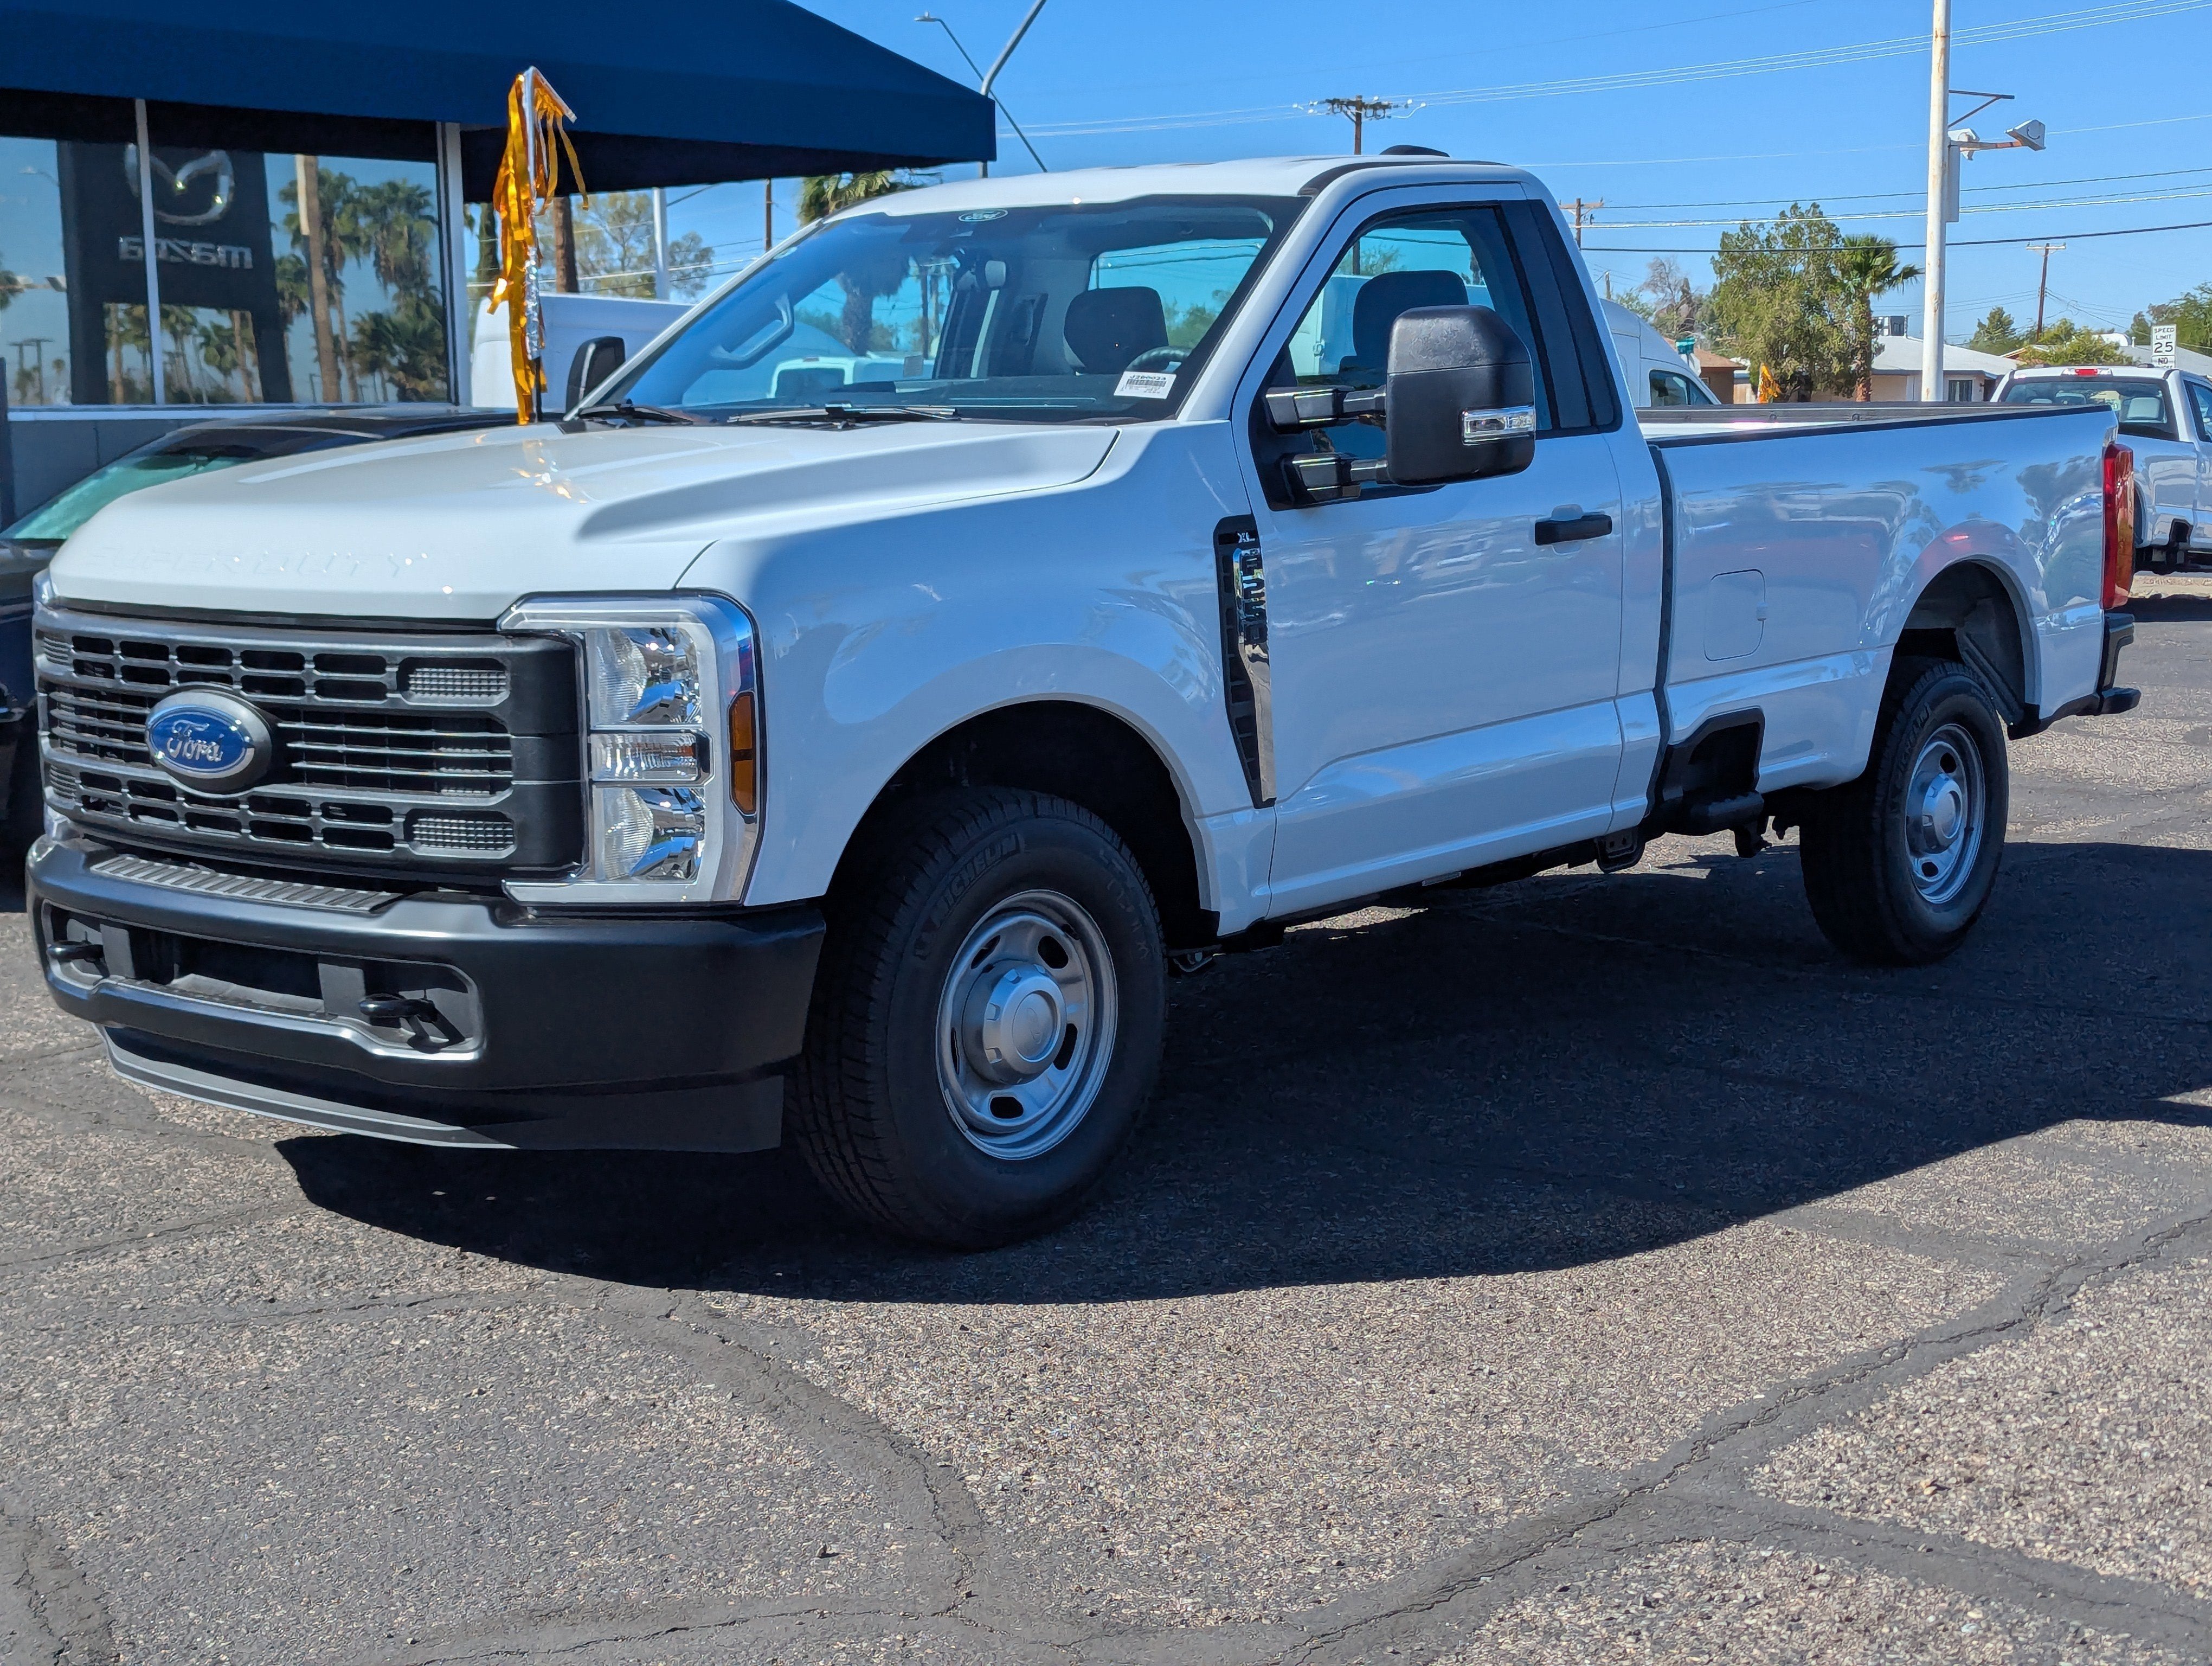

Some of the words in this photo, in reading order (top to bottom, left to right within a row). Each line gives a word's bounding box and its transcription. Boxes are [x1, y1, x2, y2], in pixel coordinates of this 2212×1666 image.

[2154, 342, 2173, 353] 25
[1237, 532, 1255, 543] XL
[166, 720, 224, 762] Ford
